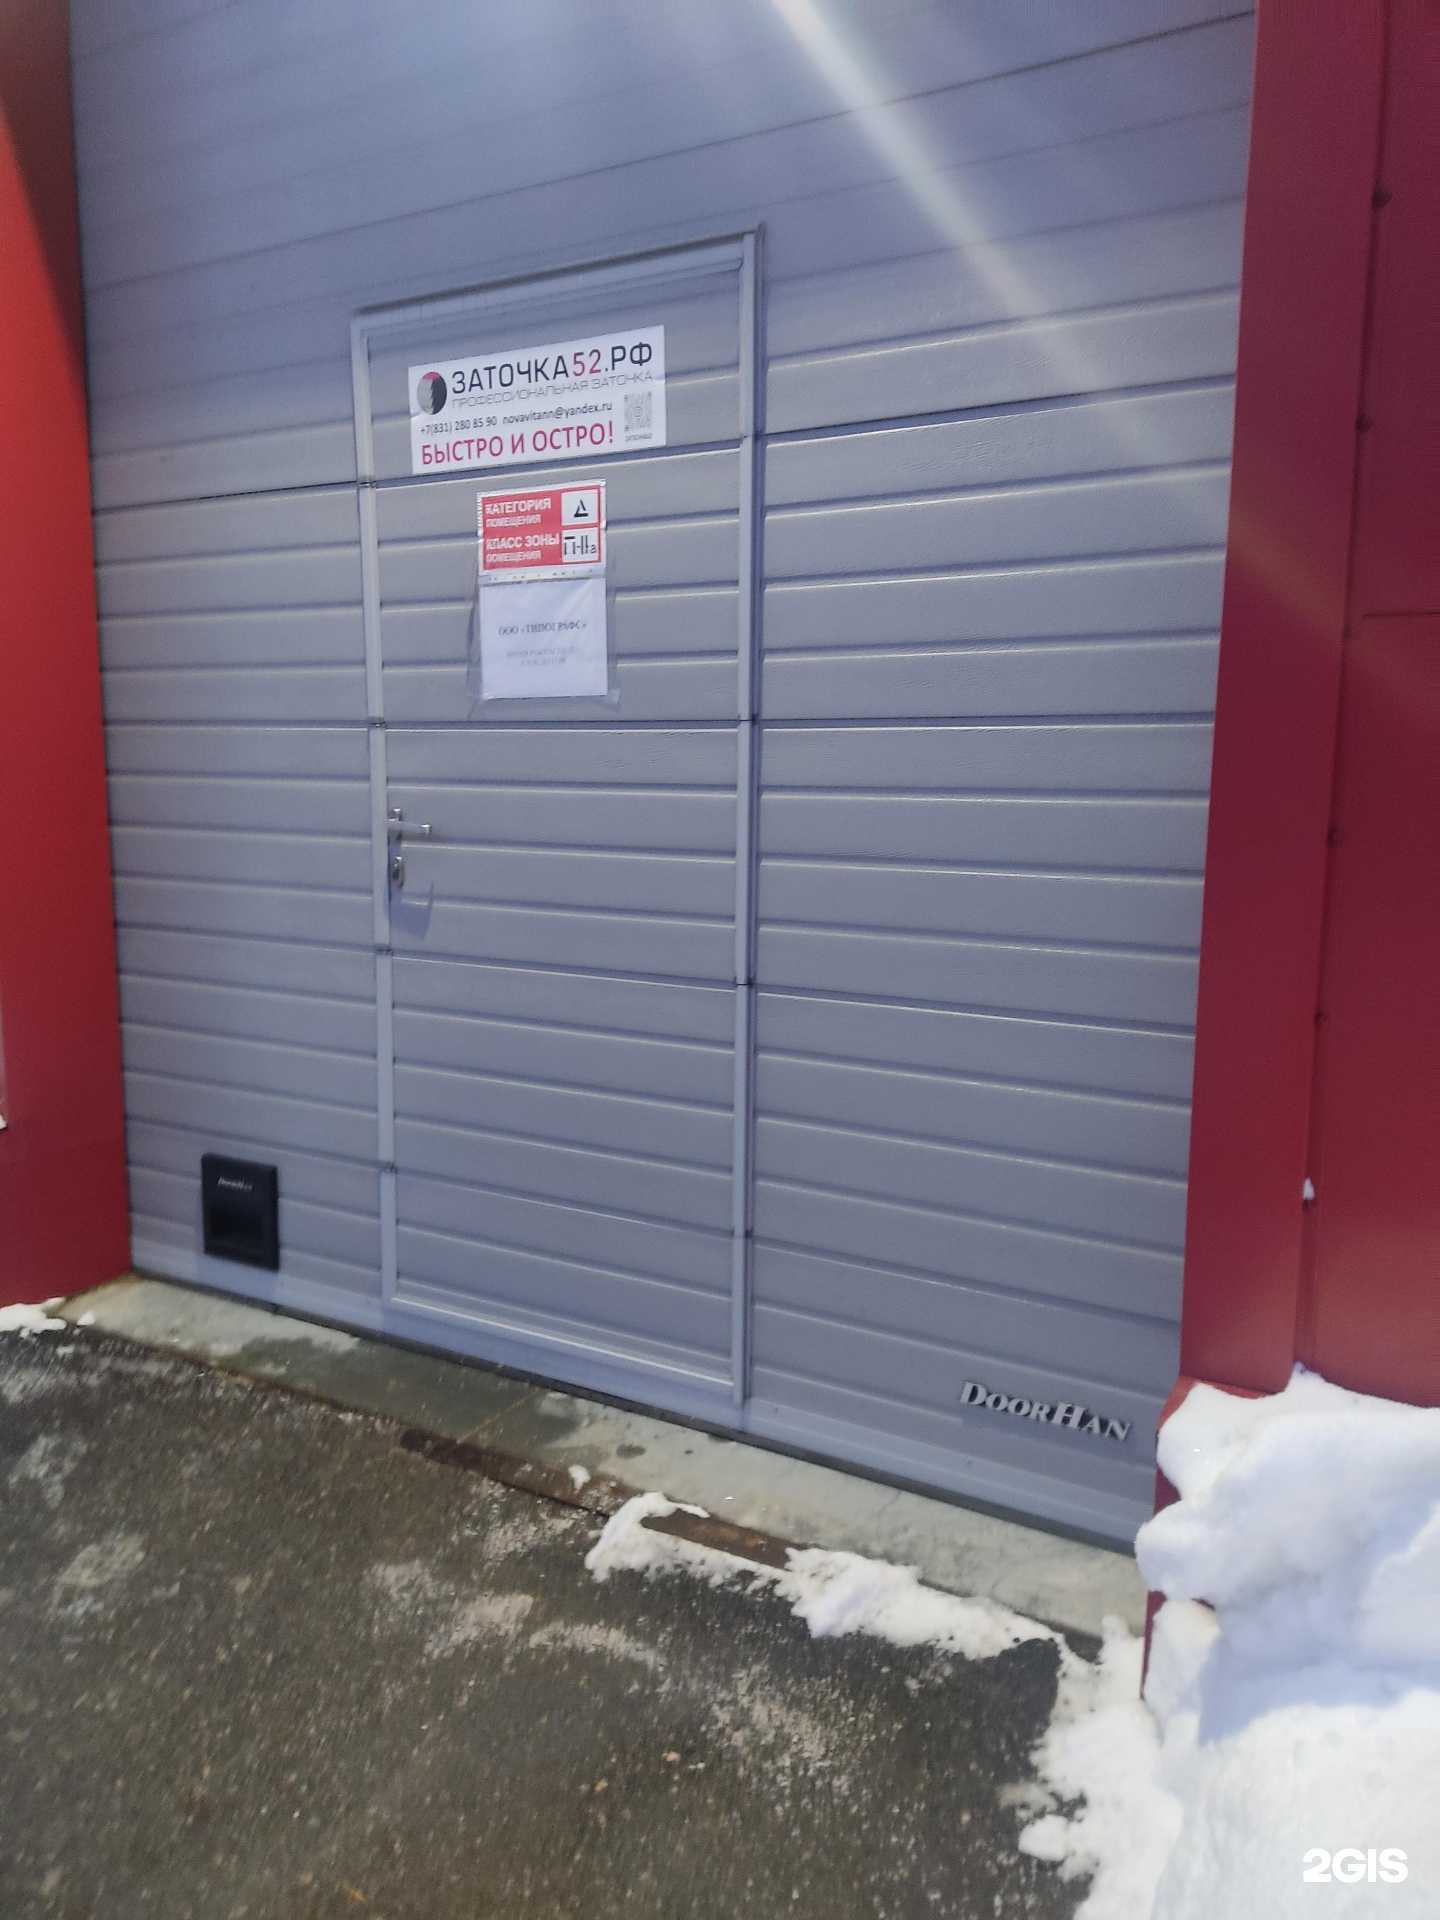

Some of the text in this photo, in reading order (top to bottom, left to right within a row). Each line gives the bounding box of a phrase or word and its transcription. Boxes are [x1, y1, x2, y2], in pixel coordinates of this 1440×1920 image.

[452, 342, 652, 394] ЗАТОЧКА52.РФ
[452, 371, 653, 408] ПРОФЕССИОНАЛЬНАЯ ЗАТОЧКА
[420, 421, 453, 435] +7(831)
[455, 419, 471, 431] 280
[472, 417, 485, 428] 85
[485, 415, 498, 426] 90
[421, 420, 614, 465] БЫСТРО И ОСТРО!
[485, 498, 551, 515] КАТЕГОРИЯ
[486, 533, 560, 550] КЛАСС ЗОНЫ
